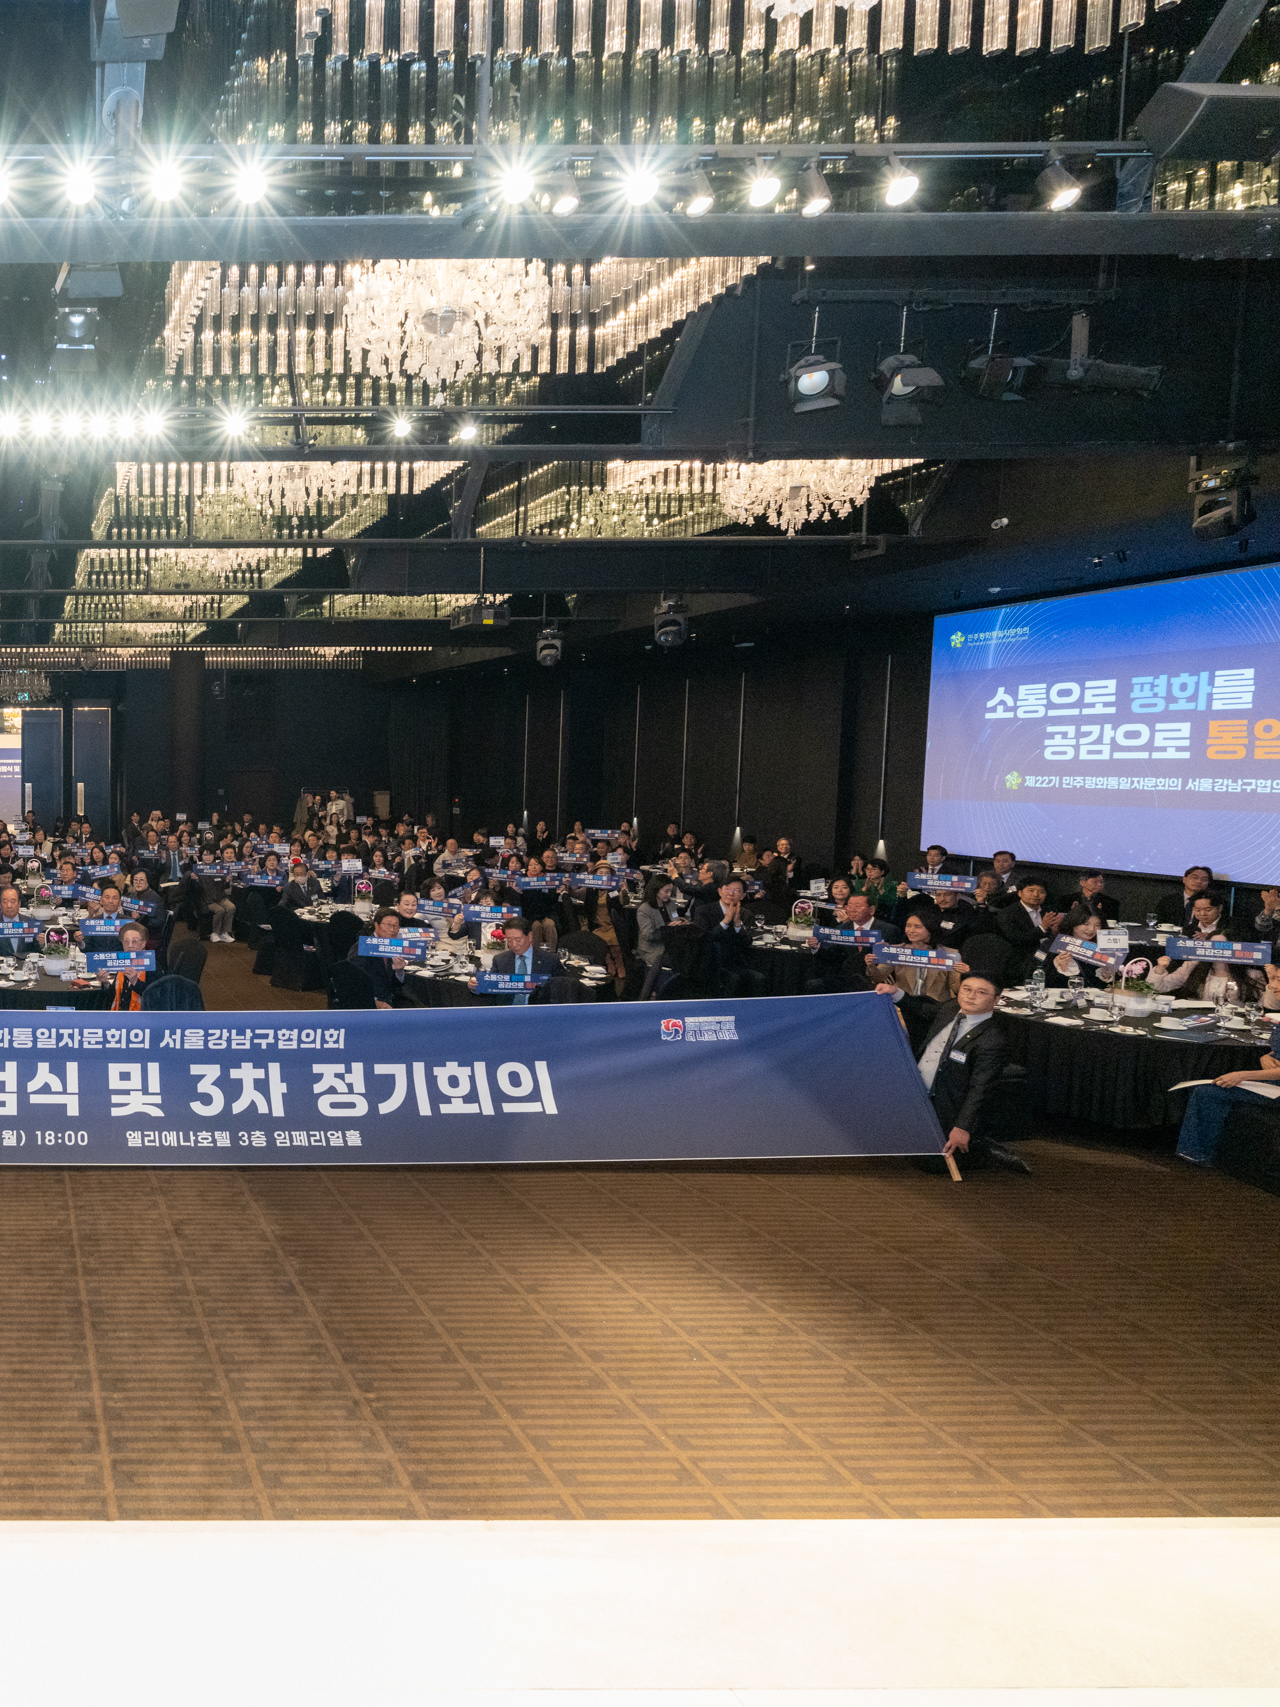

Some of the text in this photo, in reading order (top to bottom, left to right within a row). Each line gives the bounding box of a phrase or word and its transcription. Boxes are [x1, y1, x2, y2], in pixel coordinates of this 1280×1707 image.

[985, 668, 1255, 719] 소통으로 평화를
[1043, 722, 1191, 760] 공감으로
[1024, 776, 1059, 788] 제22기
[1062, 777, 1181, 791] 민주평화통일자문회의
[1177, 940, 1212, 948] 소통으로
[1196, 948, 1232, 957] 공감으로
[898, 955, 928, 963] 공감으로
[160, 1028, 346, 1050] 서울강남구협의회
[108, 1061, 166, 1117] 및
[190, 1062, 288, 1117] 3차
[312, 1060, 558, 1116] 정기회의
[36, 1130, 88, 1146] 18:00
[126, 1130, 362, 1148] 엘리에나호텔 3층 임페리얼홀
